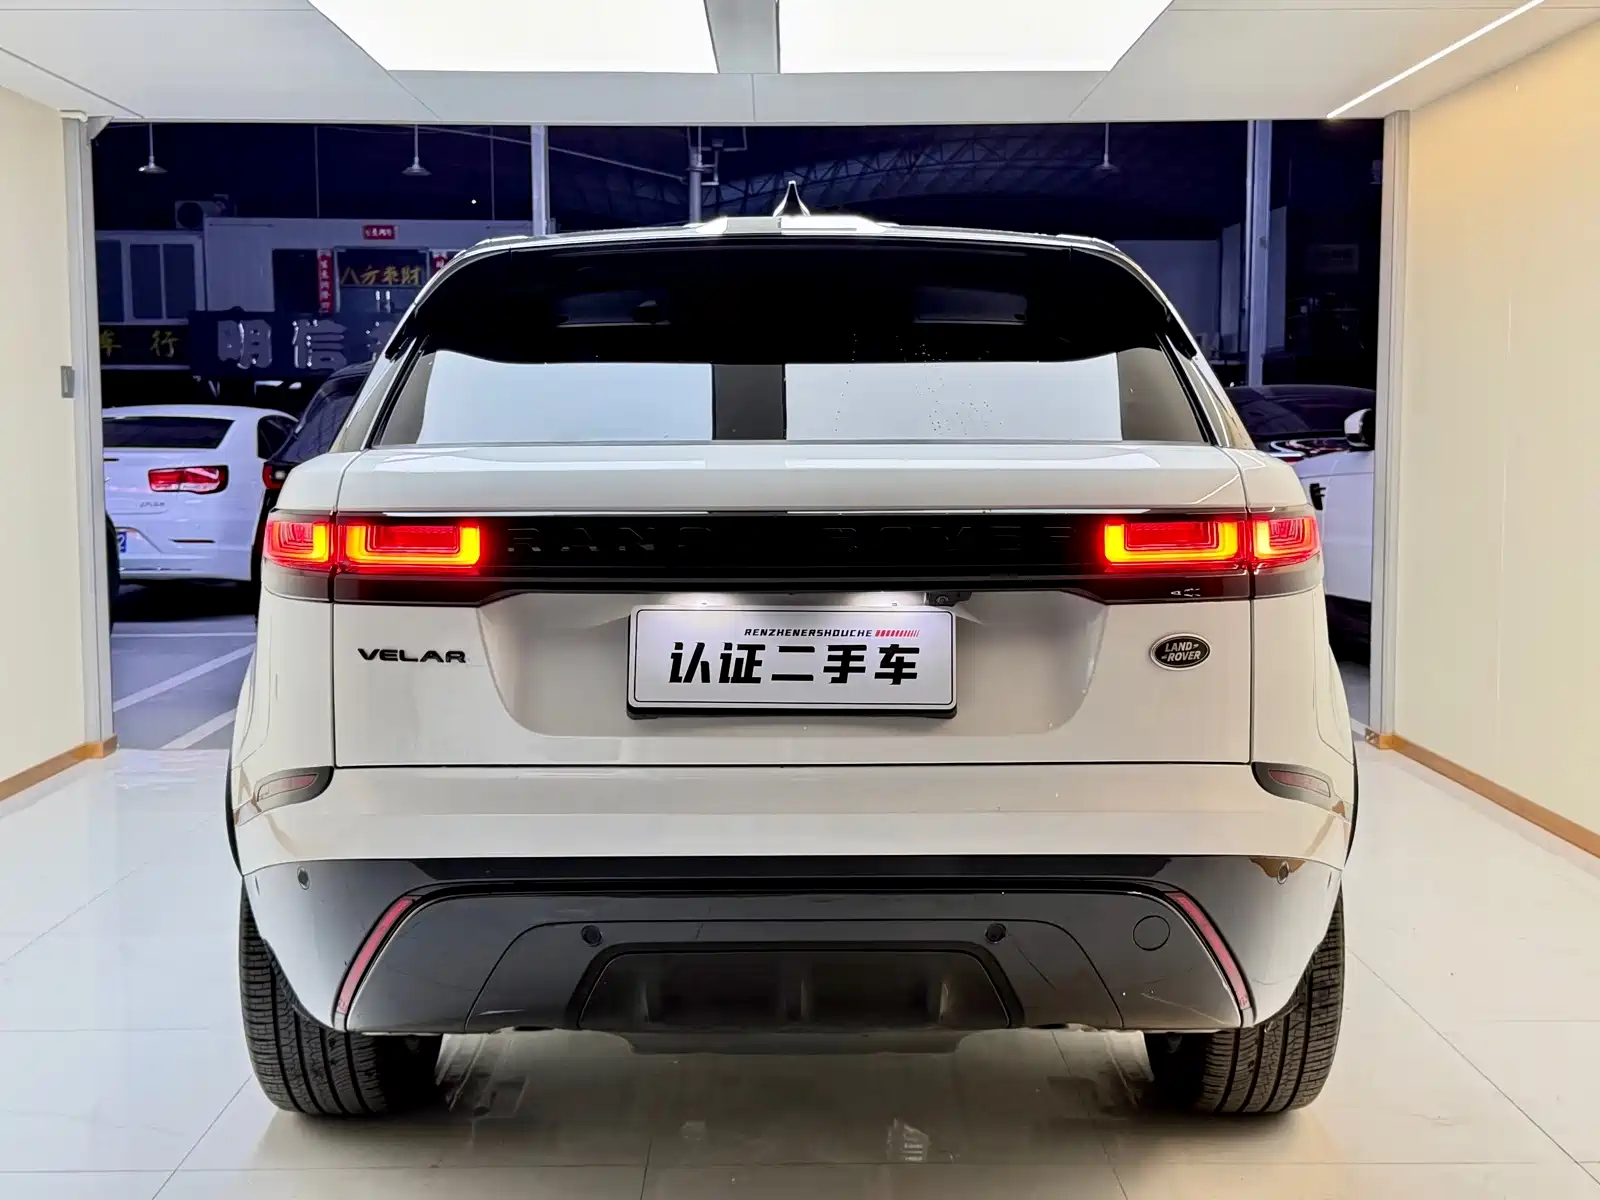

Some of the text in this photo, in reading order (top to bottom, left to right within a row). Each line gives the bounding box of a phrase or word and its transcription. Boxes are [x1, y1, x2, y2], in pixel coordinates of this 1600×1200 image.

[507, 527, 768, 552] RAN
[744, 628, 873, 637] RENZHENERSHOUCHE
[1164, 641, 1193, 653] LAND
[357, 648, 466, 663] VELAR
[1167, 650, 1201, 662] ROVER
[668, 642, 920, 685] 认证二手车
